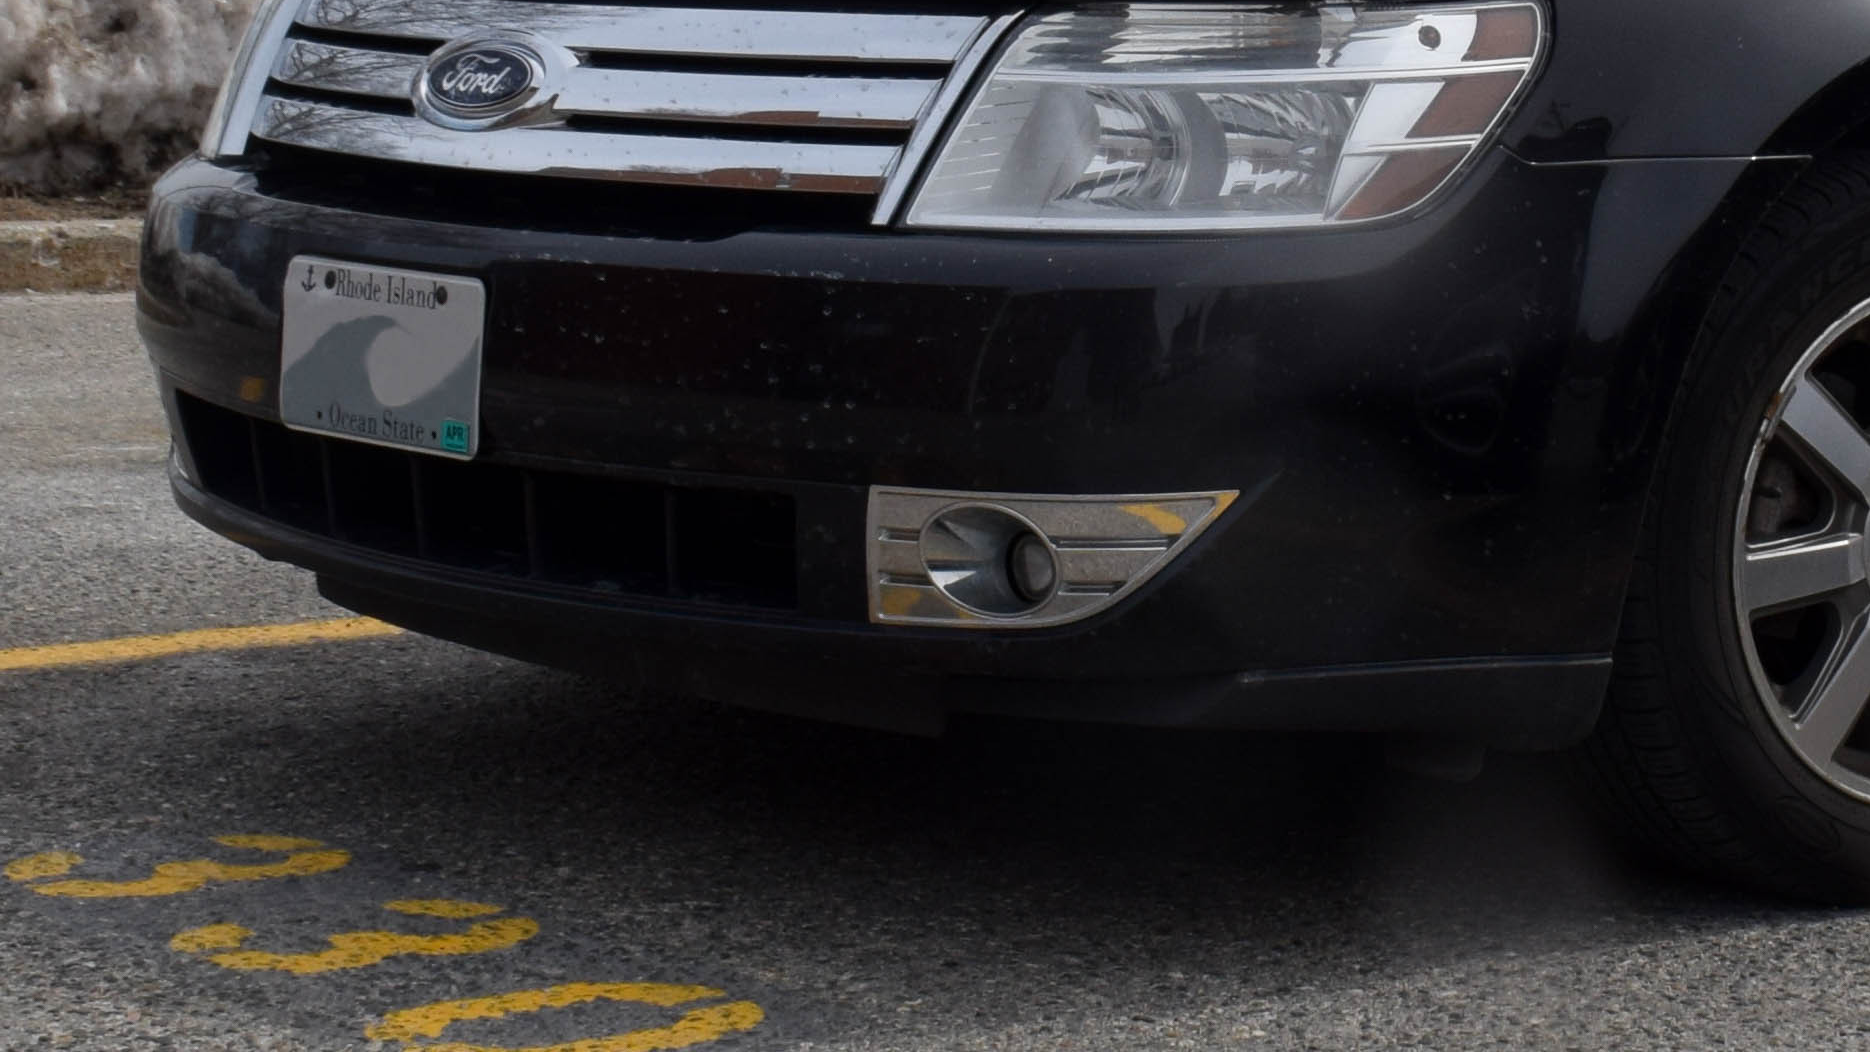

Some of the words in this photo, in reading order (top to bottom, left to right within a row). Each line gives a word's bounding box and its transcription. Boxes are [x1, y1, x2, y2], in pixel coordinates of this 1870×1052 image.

[442, 54, 511, 94] Ford
[336, 269, 381, 302] Rhode
[387, 275, 438, 309] Island
[329, 402, 377, 435] Ocean
[383, 410, 424, 440] State
